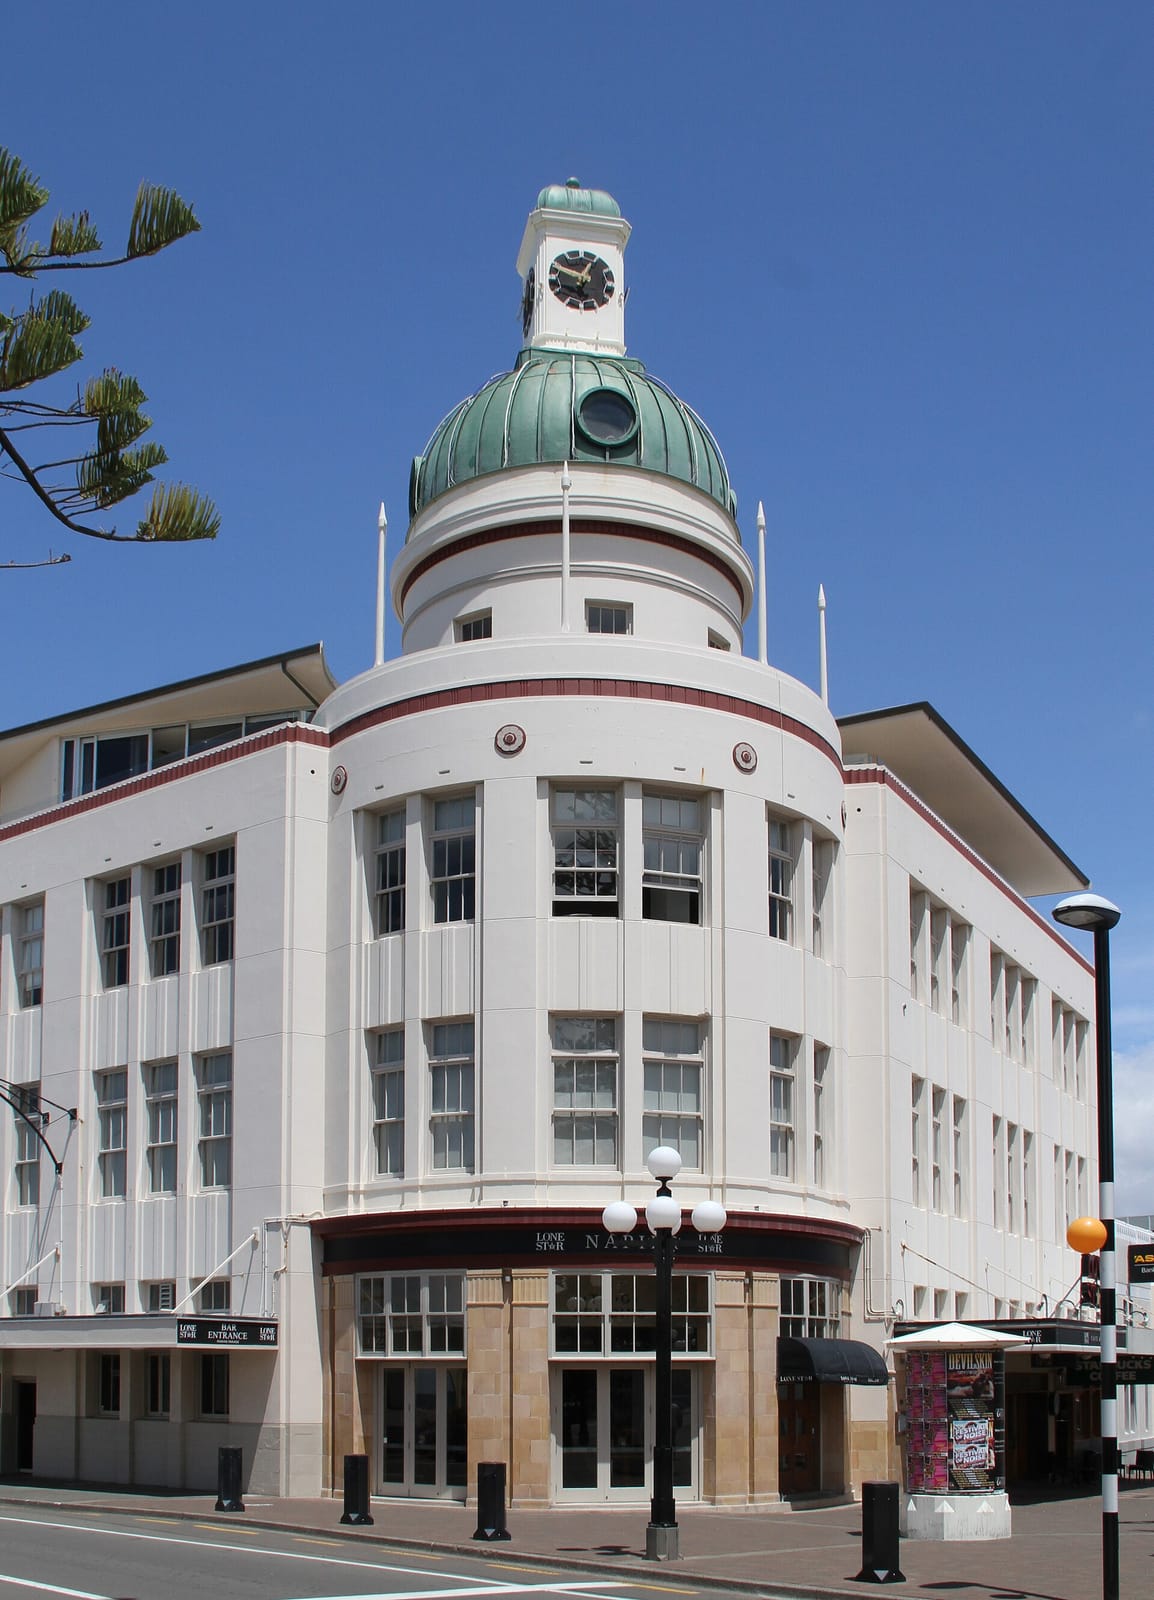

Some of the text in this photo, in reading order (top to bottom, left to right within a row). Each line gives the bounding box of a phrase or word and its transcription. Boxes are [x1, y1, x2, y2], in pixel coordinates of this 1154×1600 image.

[537, 1233, 565, 1242] LONE
[180, 1324, 197, 1332] LONE
[221, 1323, 237, 1332] BAR
[208, 1331, 248, 1340] ENTRANCE
[1022, 1329, 1042, 1337] LONE
[948, 1352, 993, 1370] DEVILSKIN
[1075, 1359, 1152, 1371] STAUCKS
[1089, 1371, 1137, 1381] CFEE
